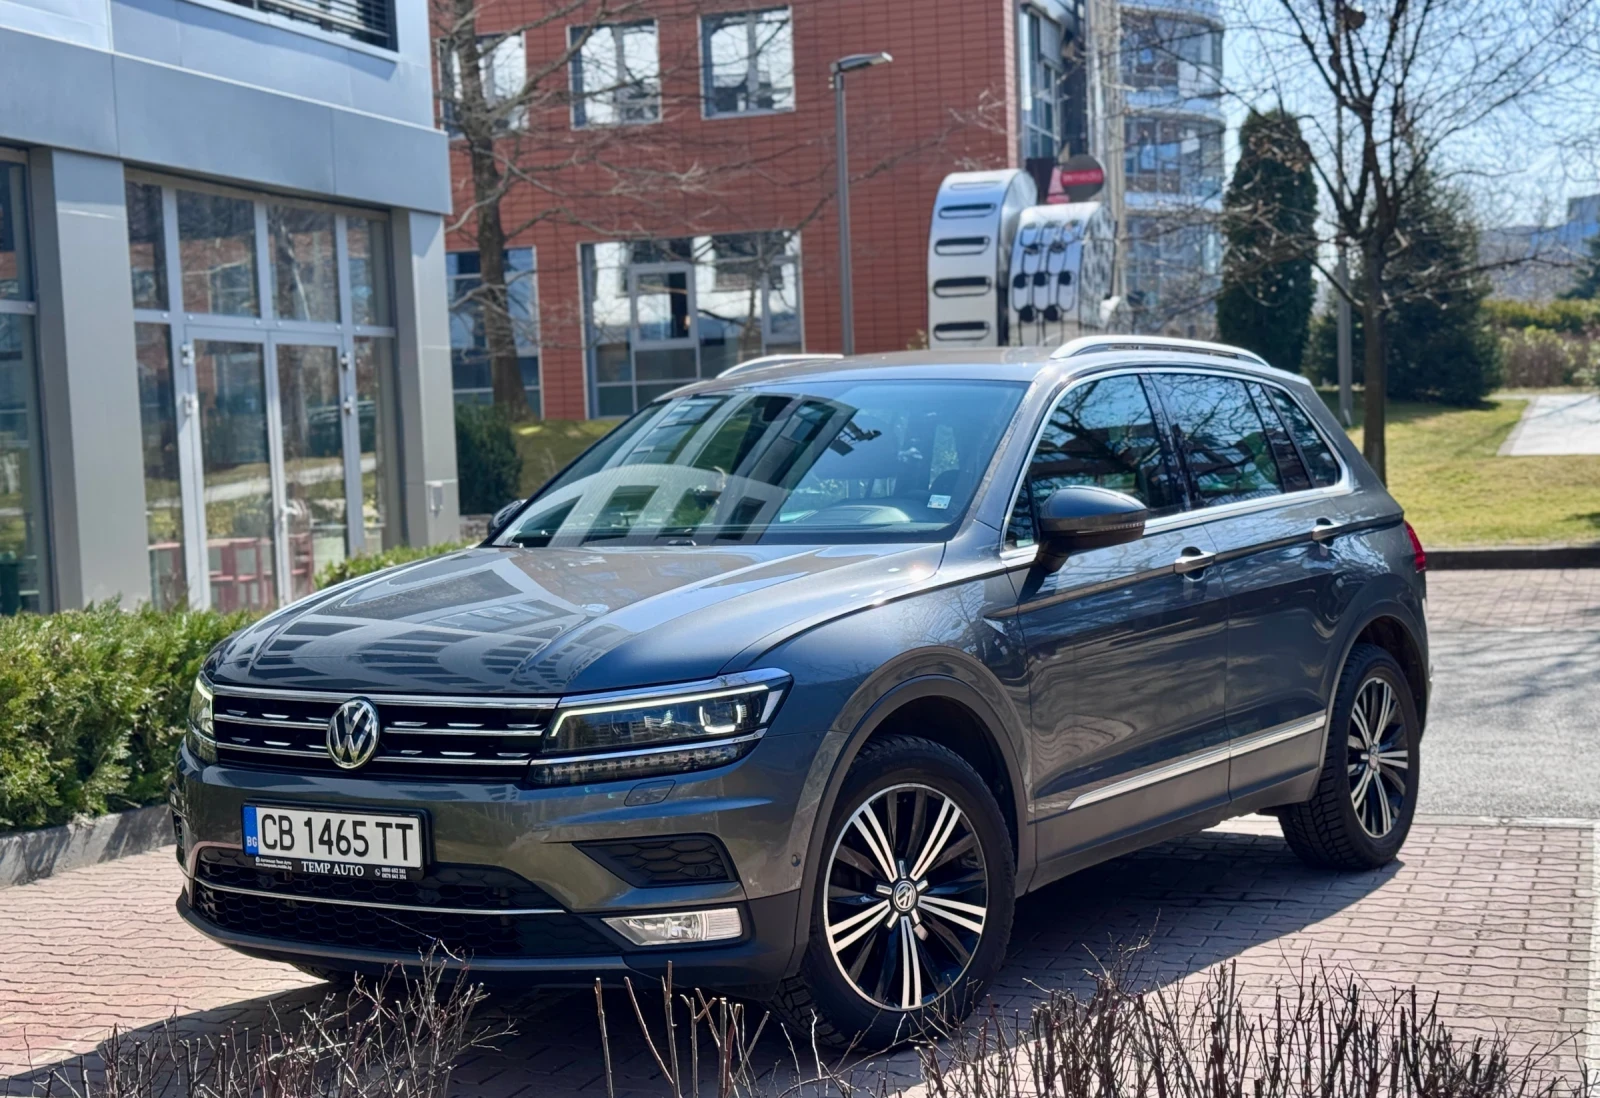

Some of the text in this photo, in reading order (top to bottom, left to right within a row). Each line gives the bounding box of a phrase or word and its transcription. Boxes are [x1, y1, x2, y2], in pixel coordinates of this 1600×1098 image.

[247, 836, 258, 848] BG
[262, 814, 413, 861] CB 1465 TT
[301, 861, 331, 874] TEMP
[333, 864, 364, 877] AUTO
